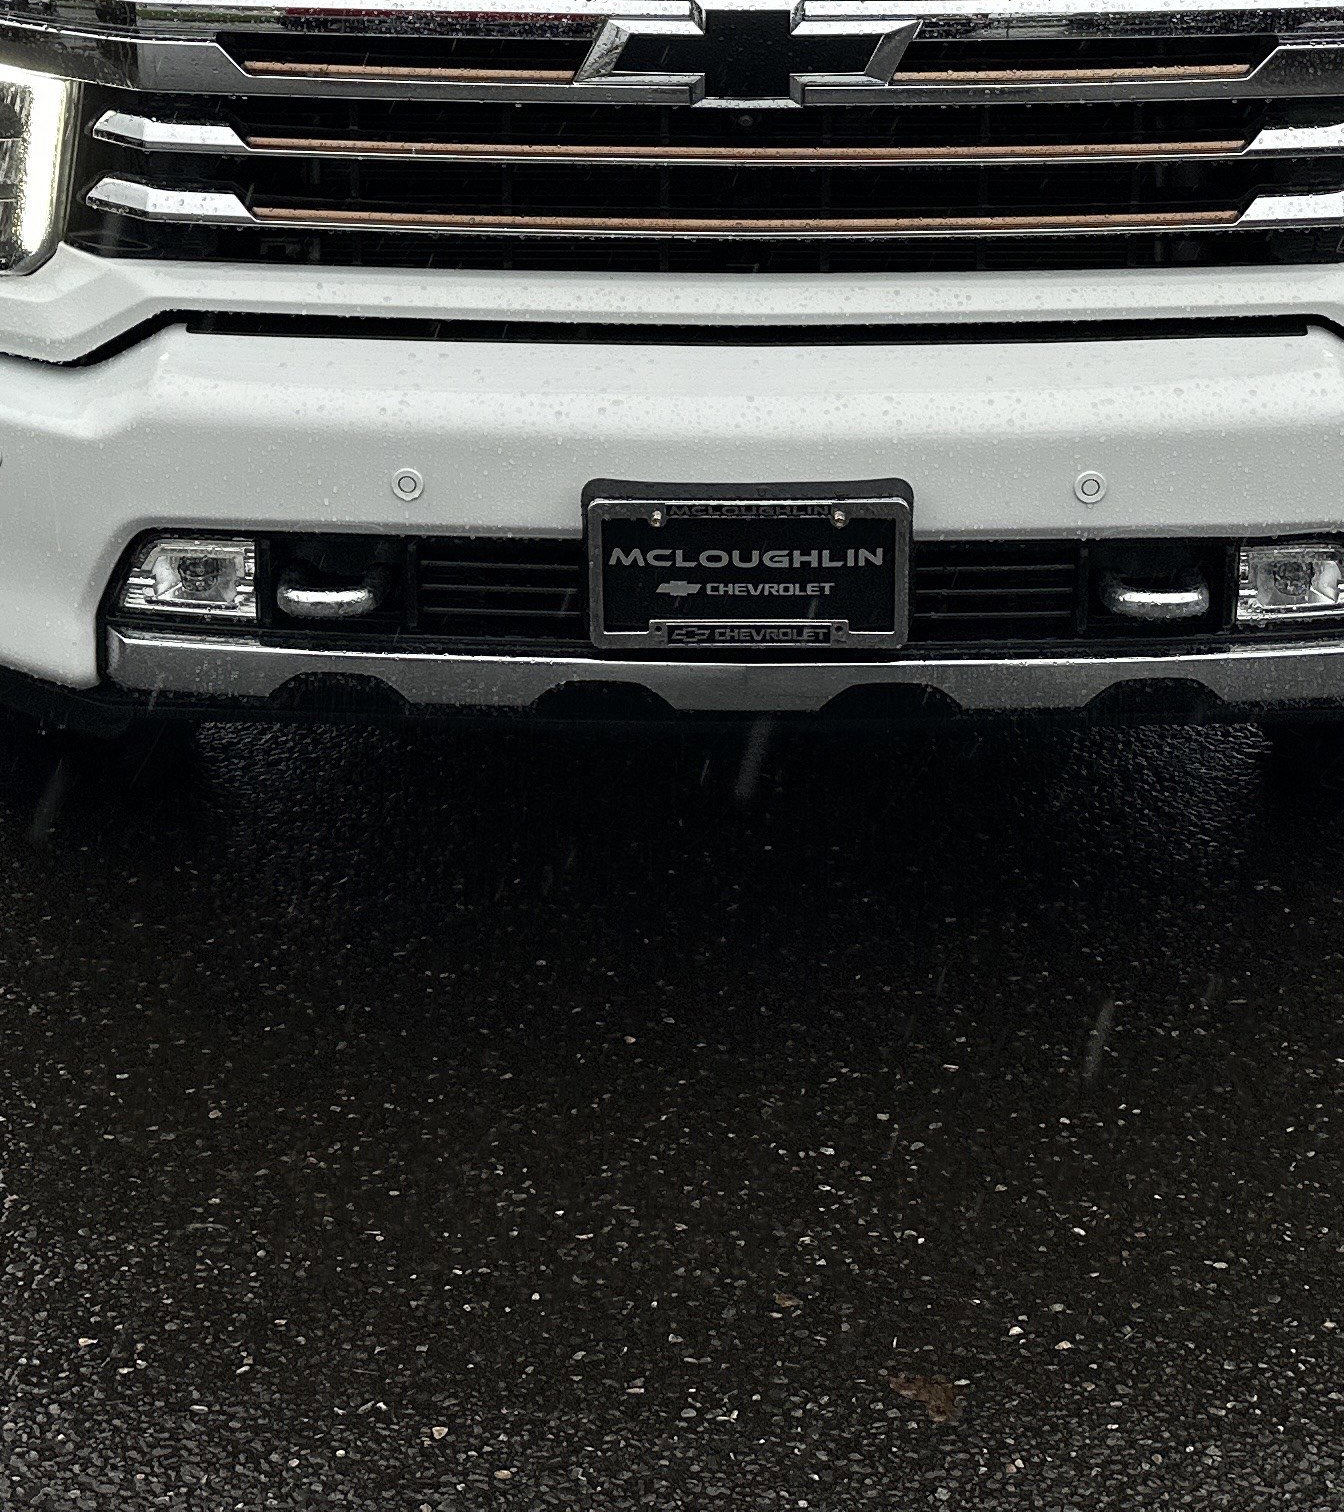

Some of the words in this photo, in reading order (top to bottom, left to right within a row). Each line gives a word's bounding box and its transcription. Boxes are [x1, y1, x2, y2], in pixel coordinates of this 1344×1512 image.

[669, 505, 830, 516] MCLOUGHLIN
[608, 547, 884, 568] MCLOUGHLIN
[706, 582, 835, 596] CHEVROLET
[714, 628, 828, 641] CHEVROLET
